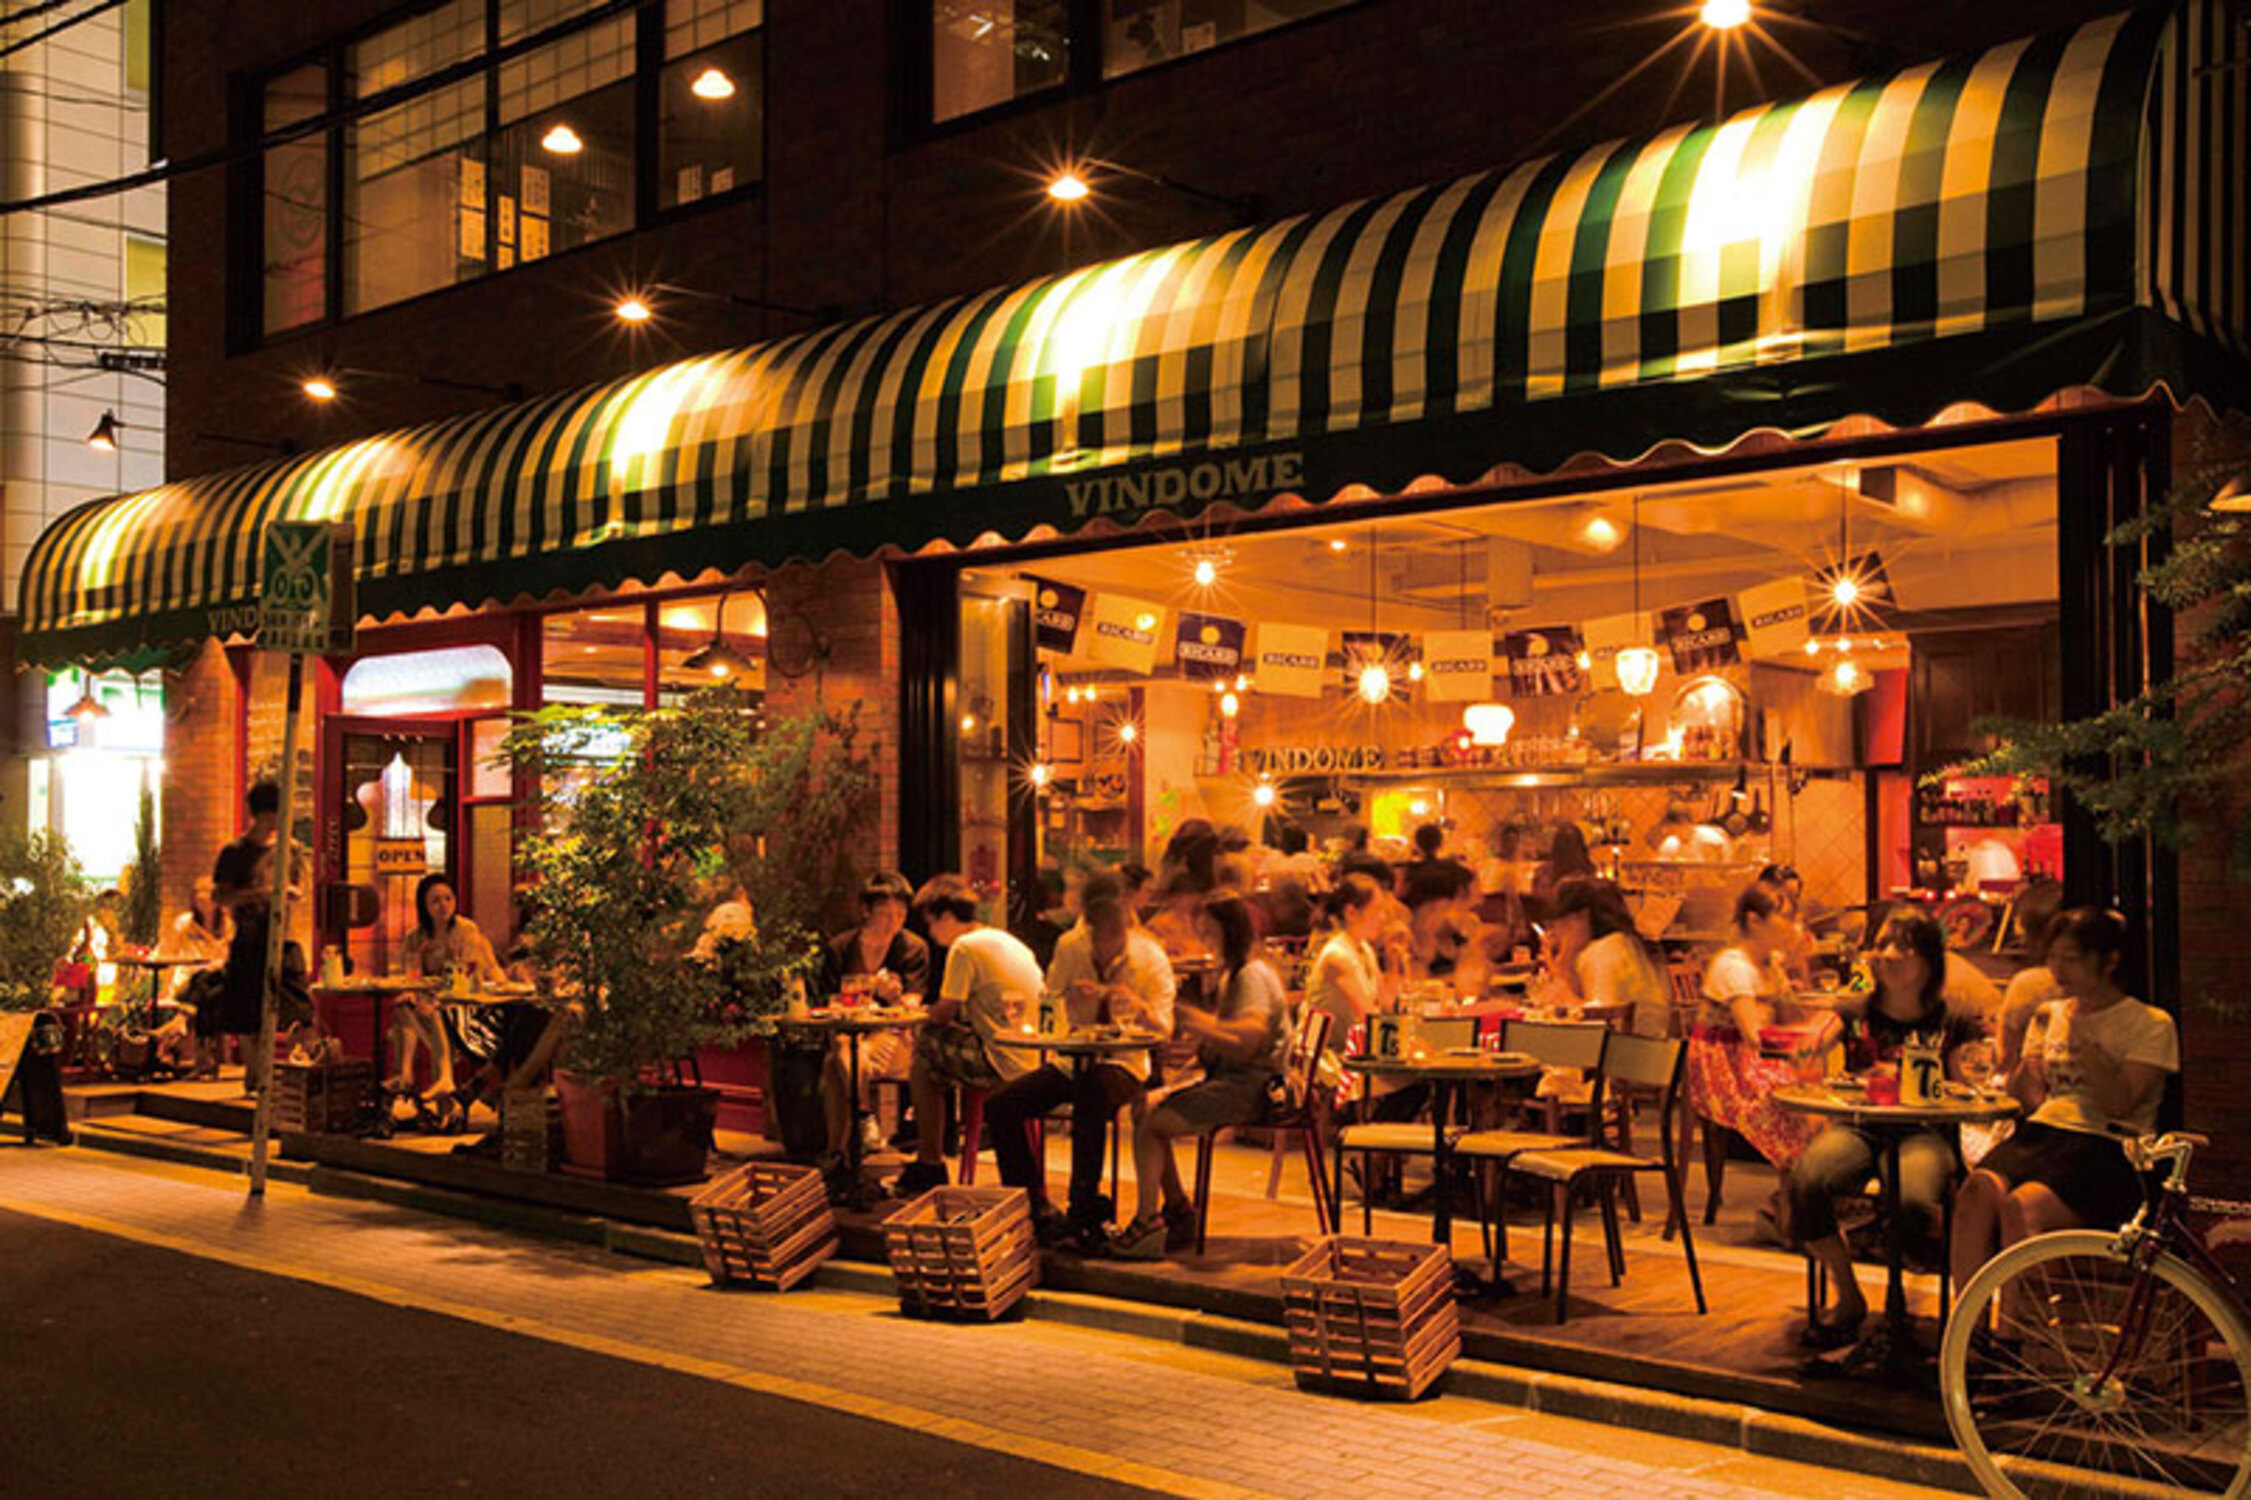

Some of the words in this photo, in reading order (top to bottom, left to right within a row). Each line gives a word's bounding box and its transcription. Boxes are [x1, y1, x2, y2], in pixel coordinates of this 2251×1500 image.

[1066, 453, 1304, 515] VINDOME
[207, 605, 258, 631] VIND
[379, 849, 426, 863] OPEN
